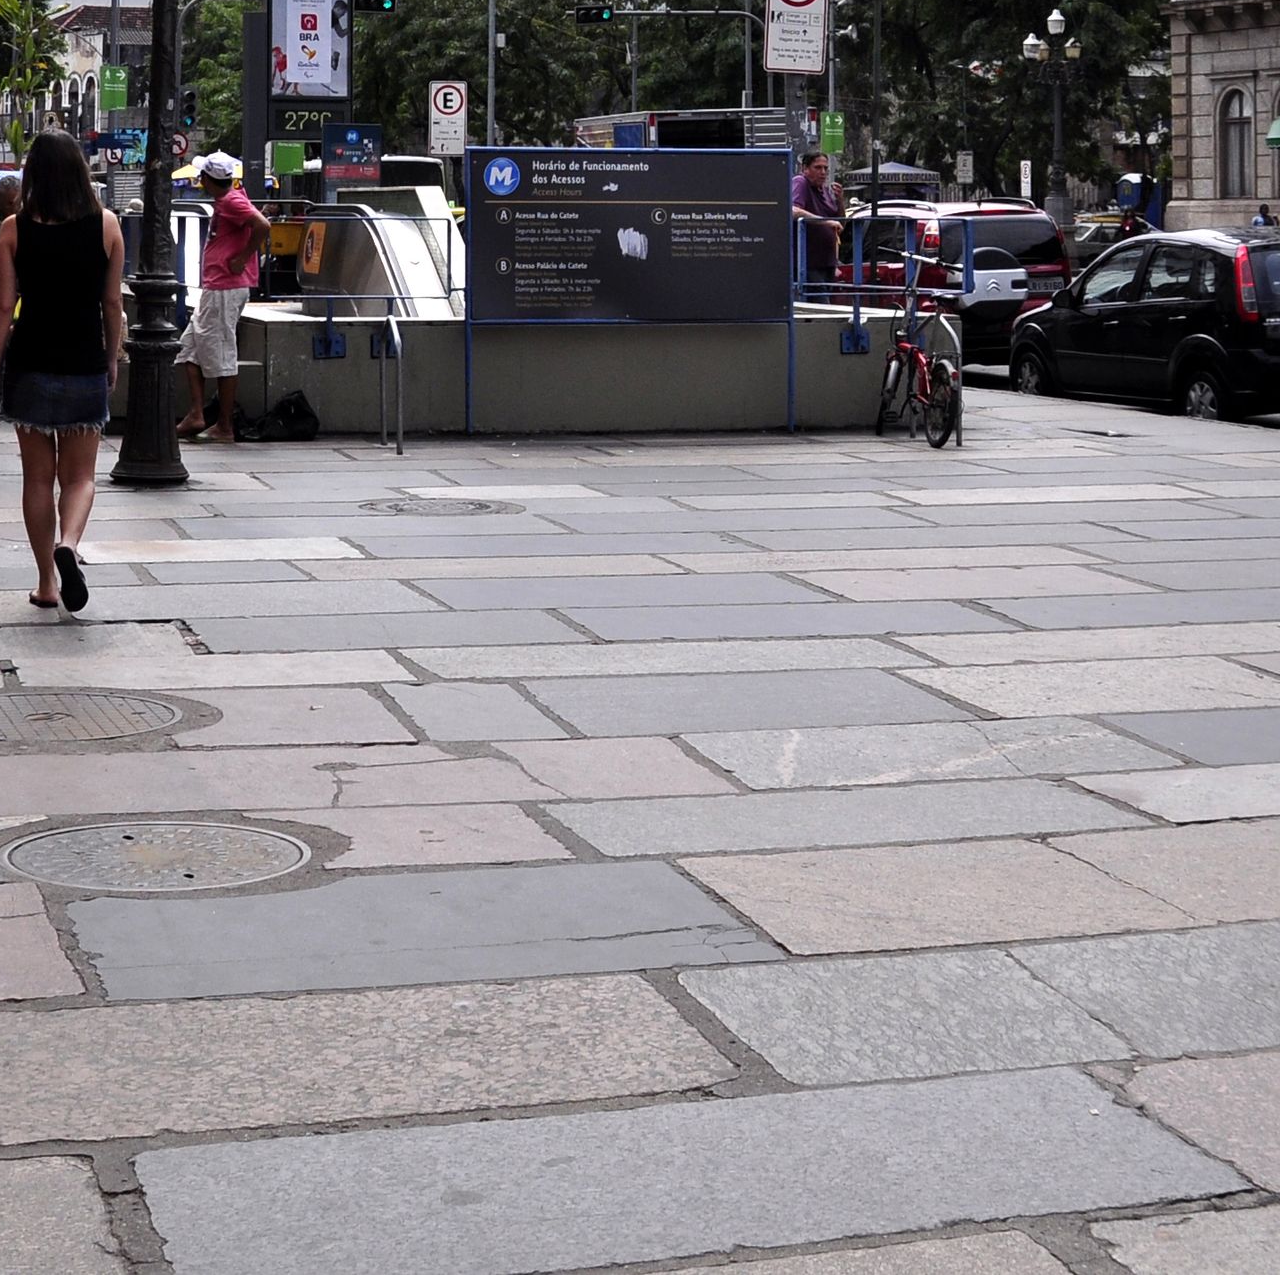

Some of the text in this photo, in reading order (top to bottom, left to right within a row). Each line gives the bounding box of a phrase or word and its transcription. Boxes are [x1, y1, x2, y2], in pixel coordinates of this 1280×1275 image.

[299, 32, 320, 41] BRA
[442, 91, 454, 110] E
[532, 160, 650, 172] Horário de Funcionamento
[532, 174, 586, 185] dos Acessos
[531, 188, 583, 197] Access Hours
[500, 210, 579, 221] A Acesso Rua do Catete
[654, 210, 749, 222] C Acesso Rua Silveira Martins
[500, 260, 588, 272] B Acesso Palácio do Catete
